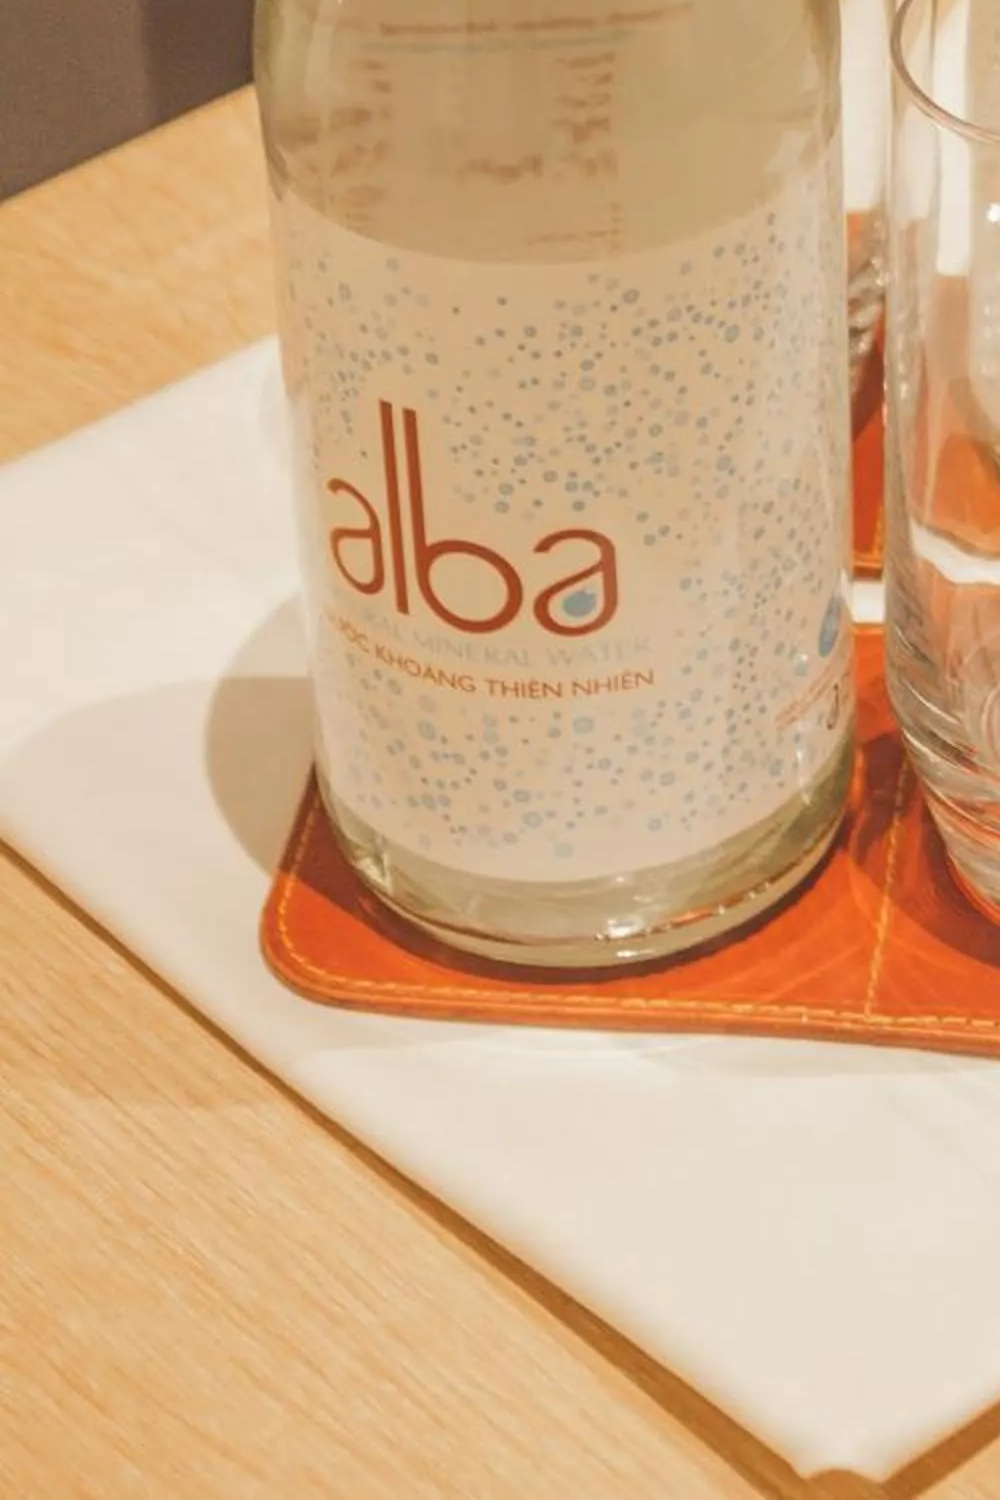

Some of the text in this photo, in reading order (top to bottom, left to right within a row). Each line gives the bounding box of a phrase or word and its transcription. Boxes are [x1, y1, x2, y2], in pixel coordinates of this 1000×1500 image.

[326, 399, 619, 637] alba
[485, 675, 563, 699] THIÊN
[571, 668, 655, 698] NHIÊN
